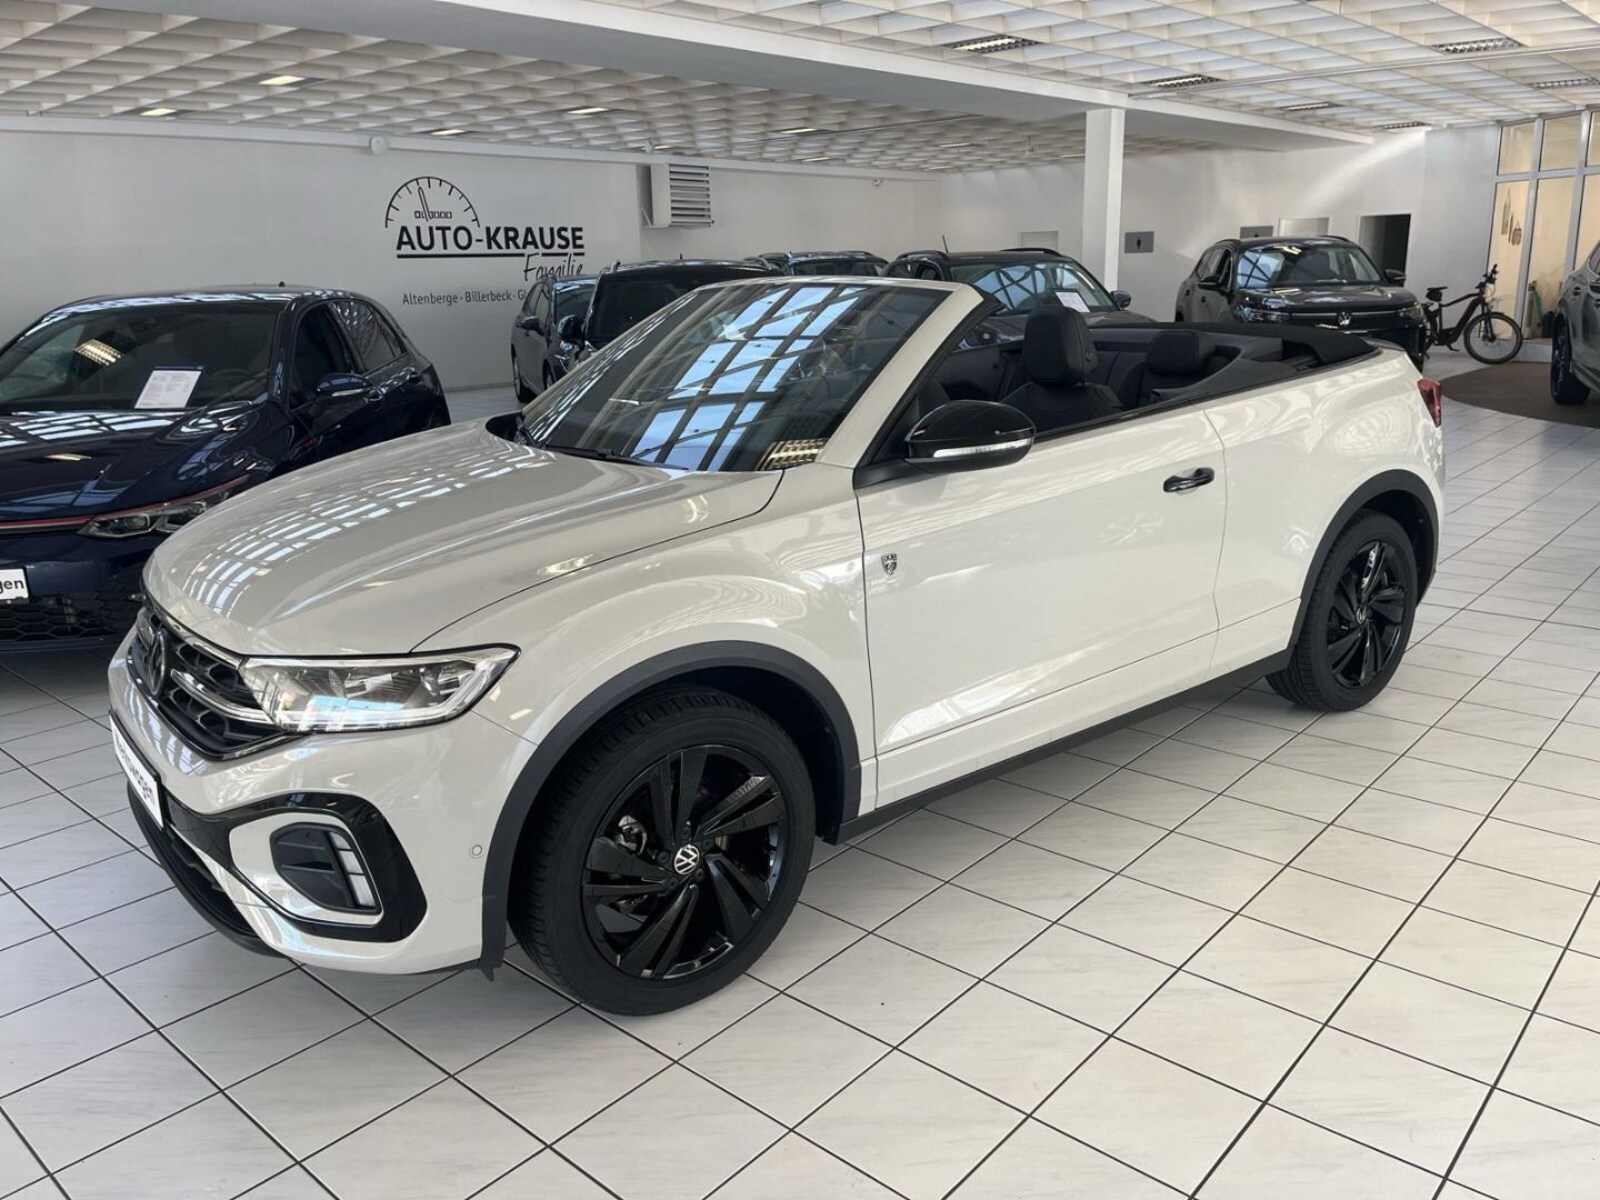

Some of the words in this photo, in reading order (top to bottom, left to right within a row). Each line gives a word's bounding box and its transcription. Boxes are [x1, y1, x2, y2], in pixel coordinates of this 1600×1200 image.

[396, 226, 585, 251] AUTO-KRAUSE
[523, 252, 584, 281] Familie
[402, 293, 459, 306] Altenberge
[464, 289, 513, 303] Billerbeck
